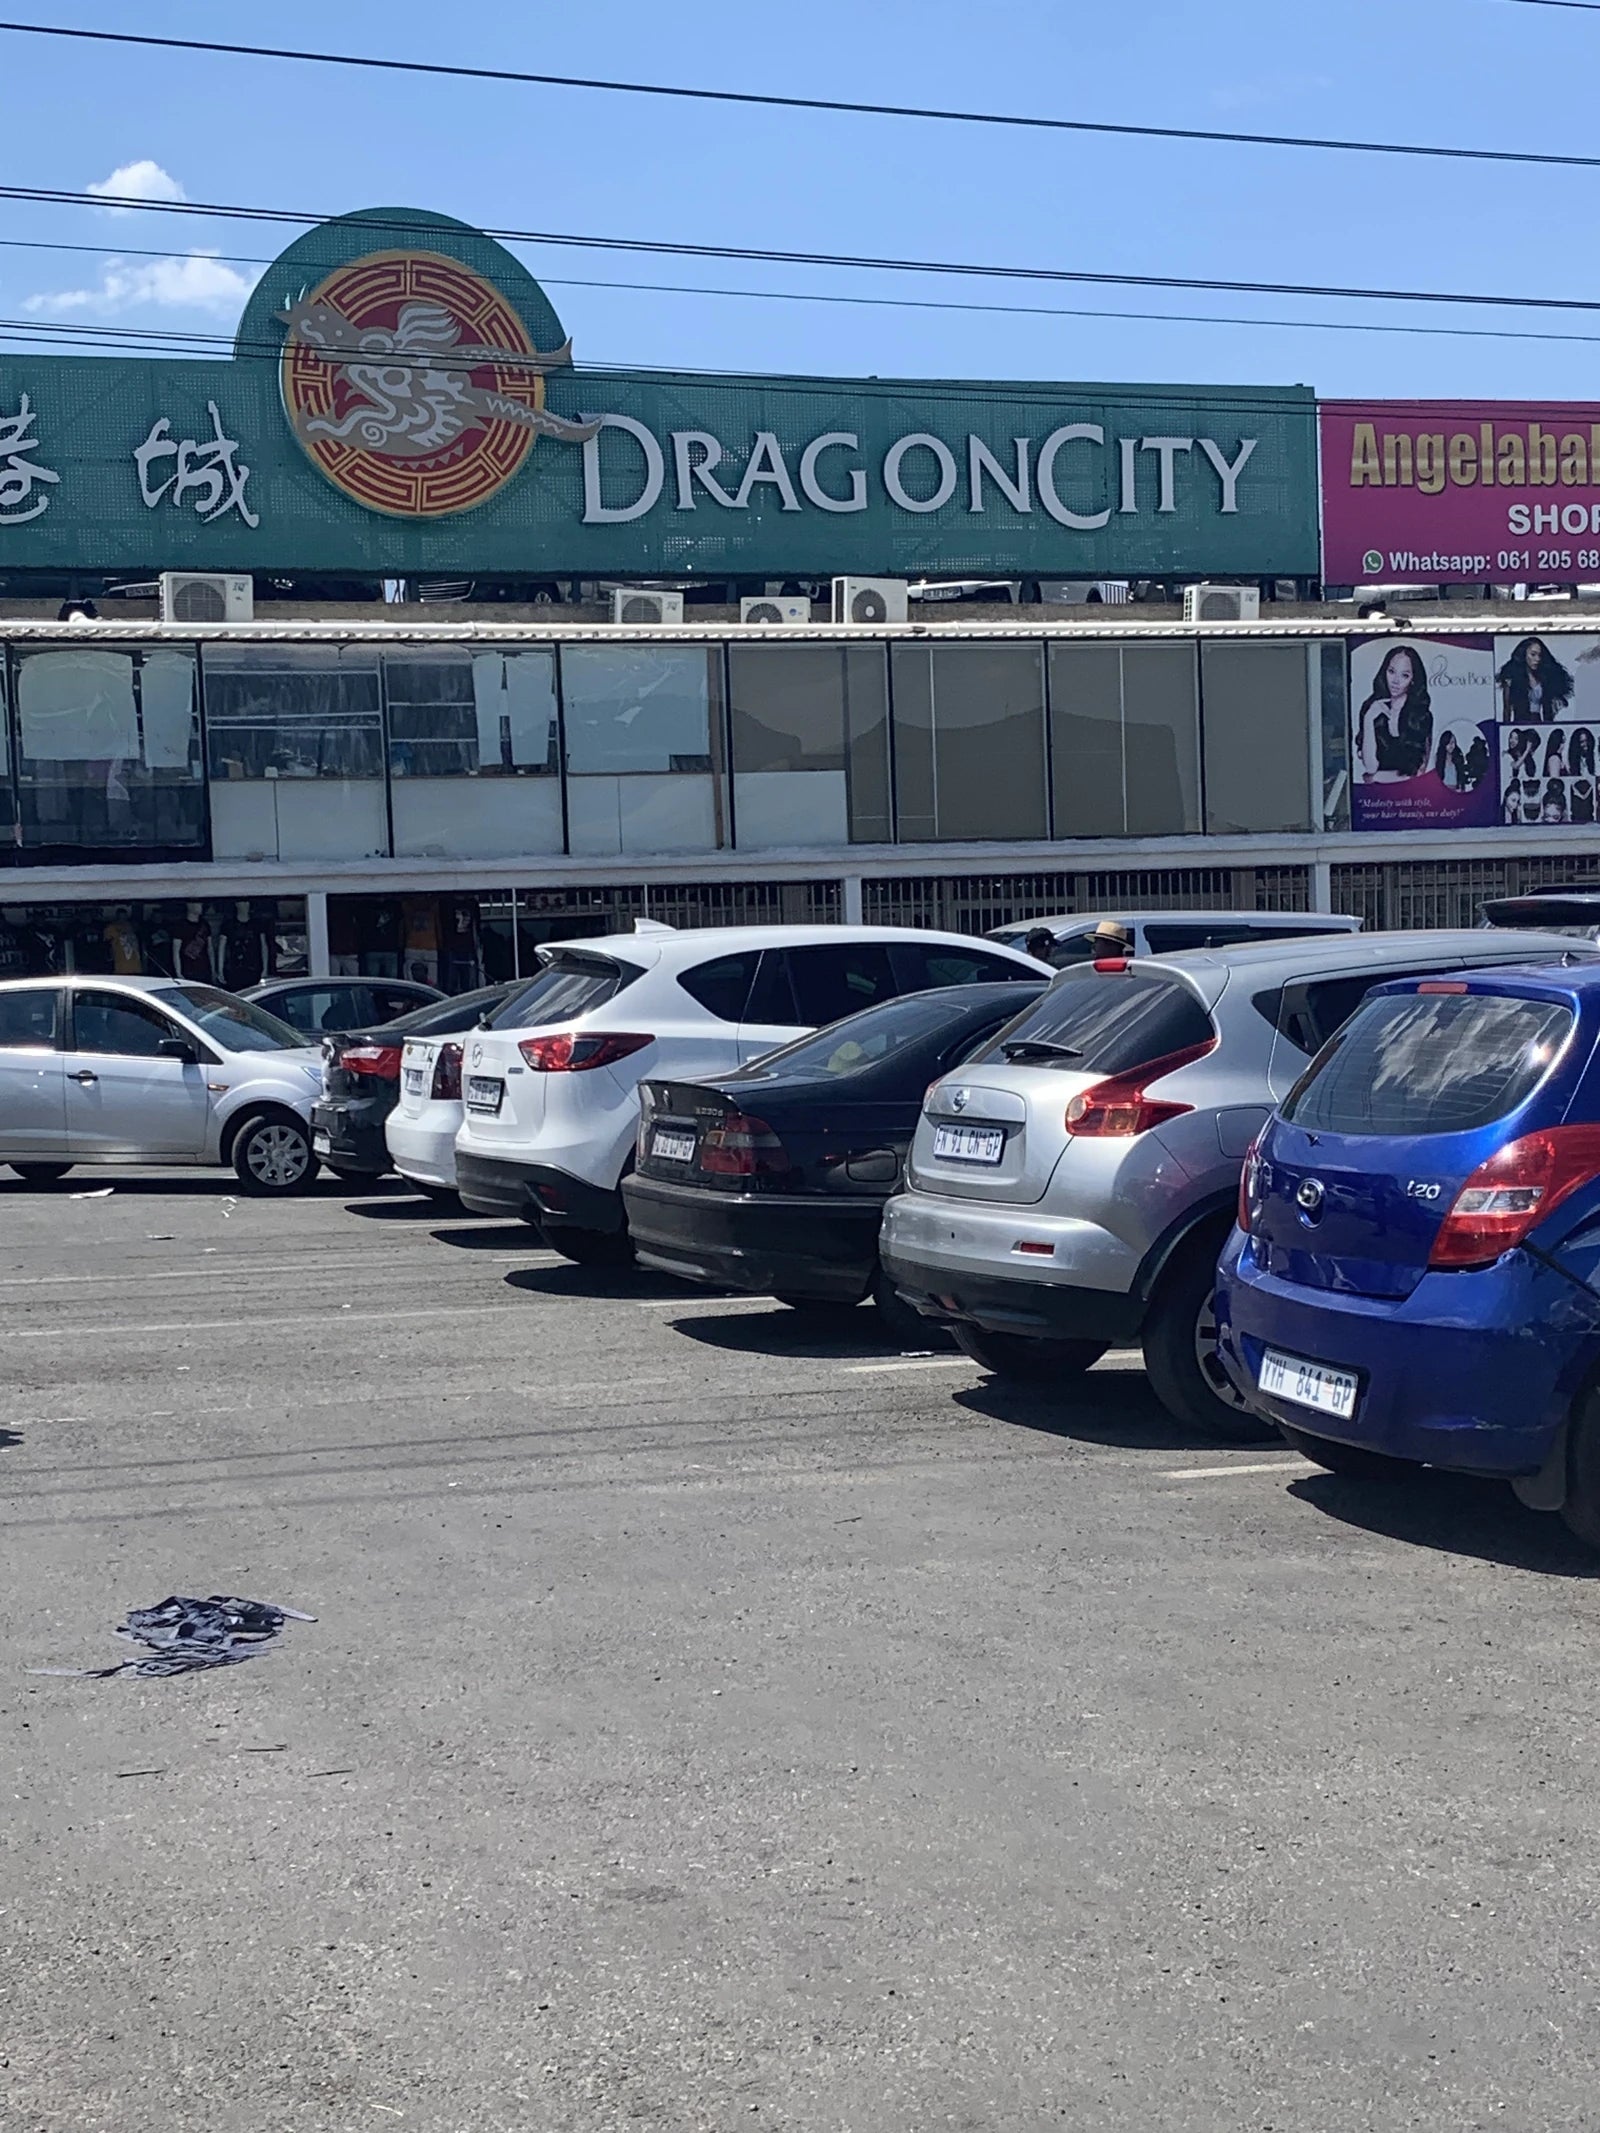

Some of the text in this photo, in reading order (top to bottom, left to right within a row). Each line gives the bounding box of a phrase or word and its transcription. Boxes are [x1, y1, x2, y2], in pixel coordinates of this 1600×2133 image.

[1350, 422, 1600, 494] Angelaba
[1389, 549, 1600, 575] Whatsapp: 061 205 68
[1296, 1366, 1323, 1402] 841
[1332, 1376, 1353, 1410] GP
